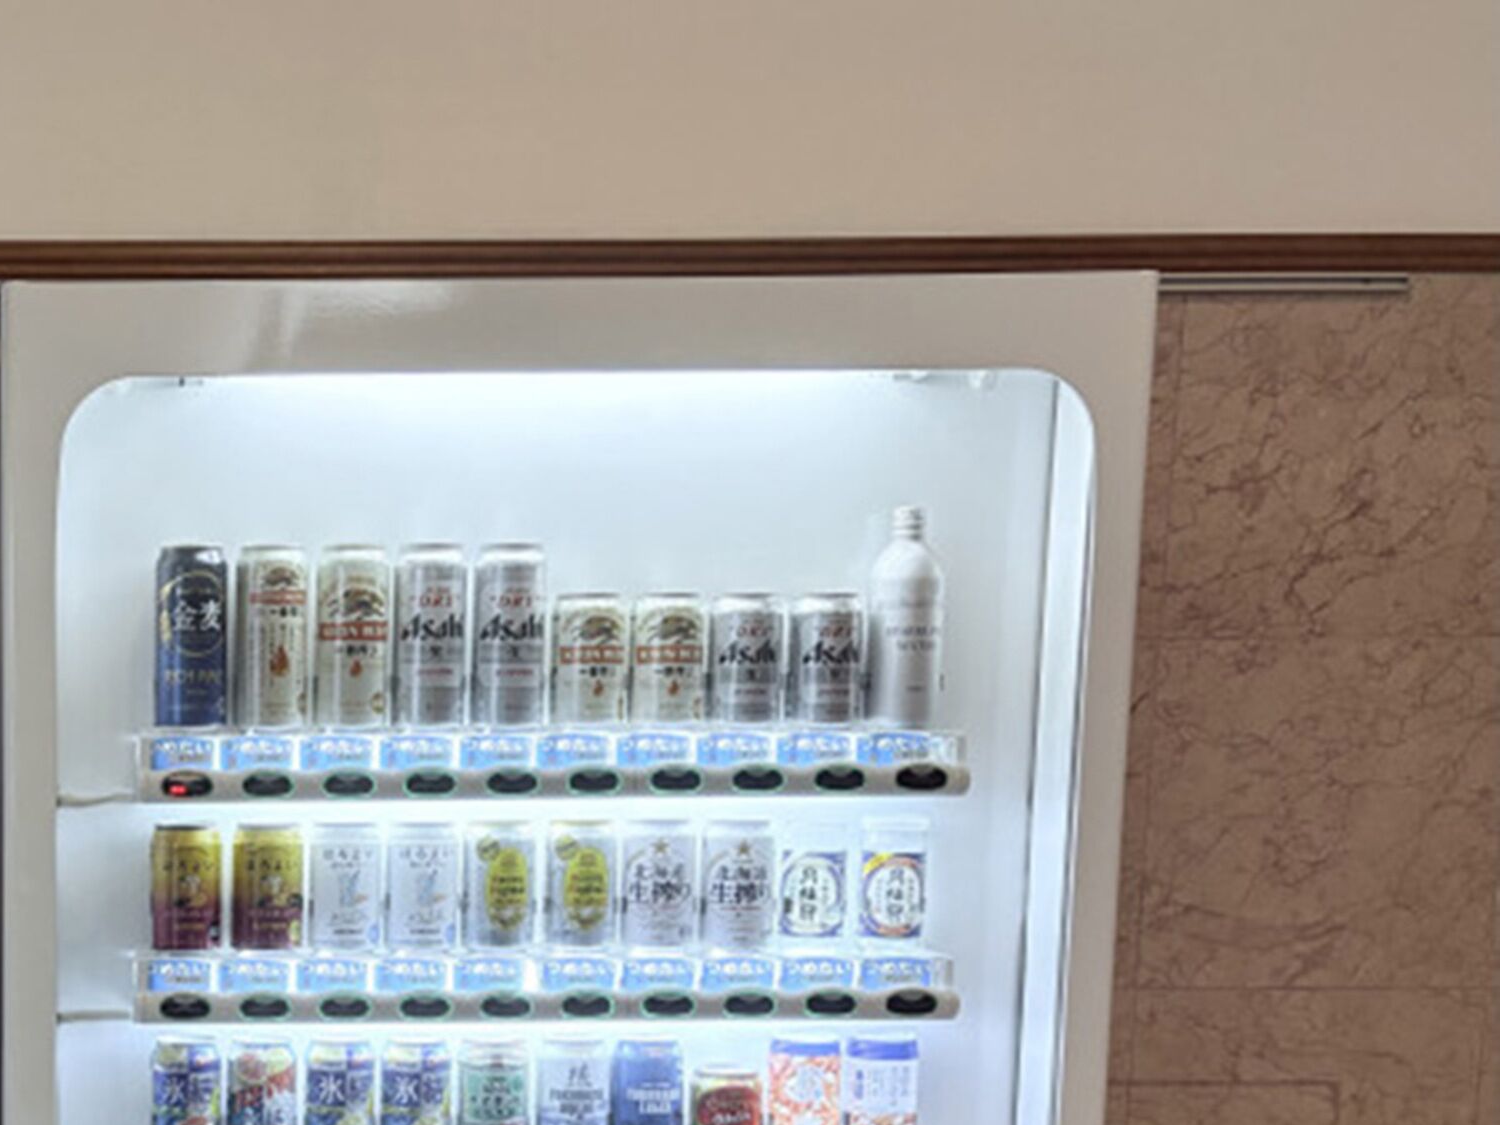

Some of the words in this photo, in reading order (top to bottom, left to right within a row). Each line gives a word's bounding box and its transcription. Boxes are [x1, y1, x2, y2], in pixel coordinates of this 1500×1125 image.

[172, 599, 222, 631] 金麦
[401, 614, 465, 640] Asahi
[481, 614, 544, 640] Asahi
